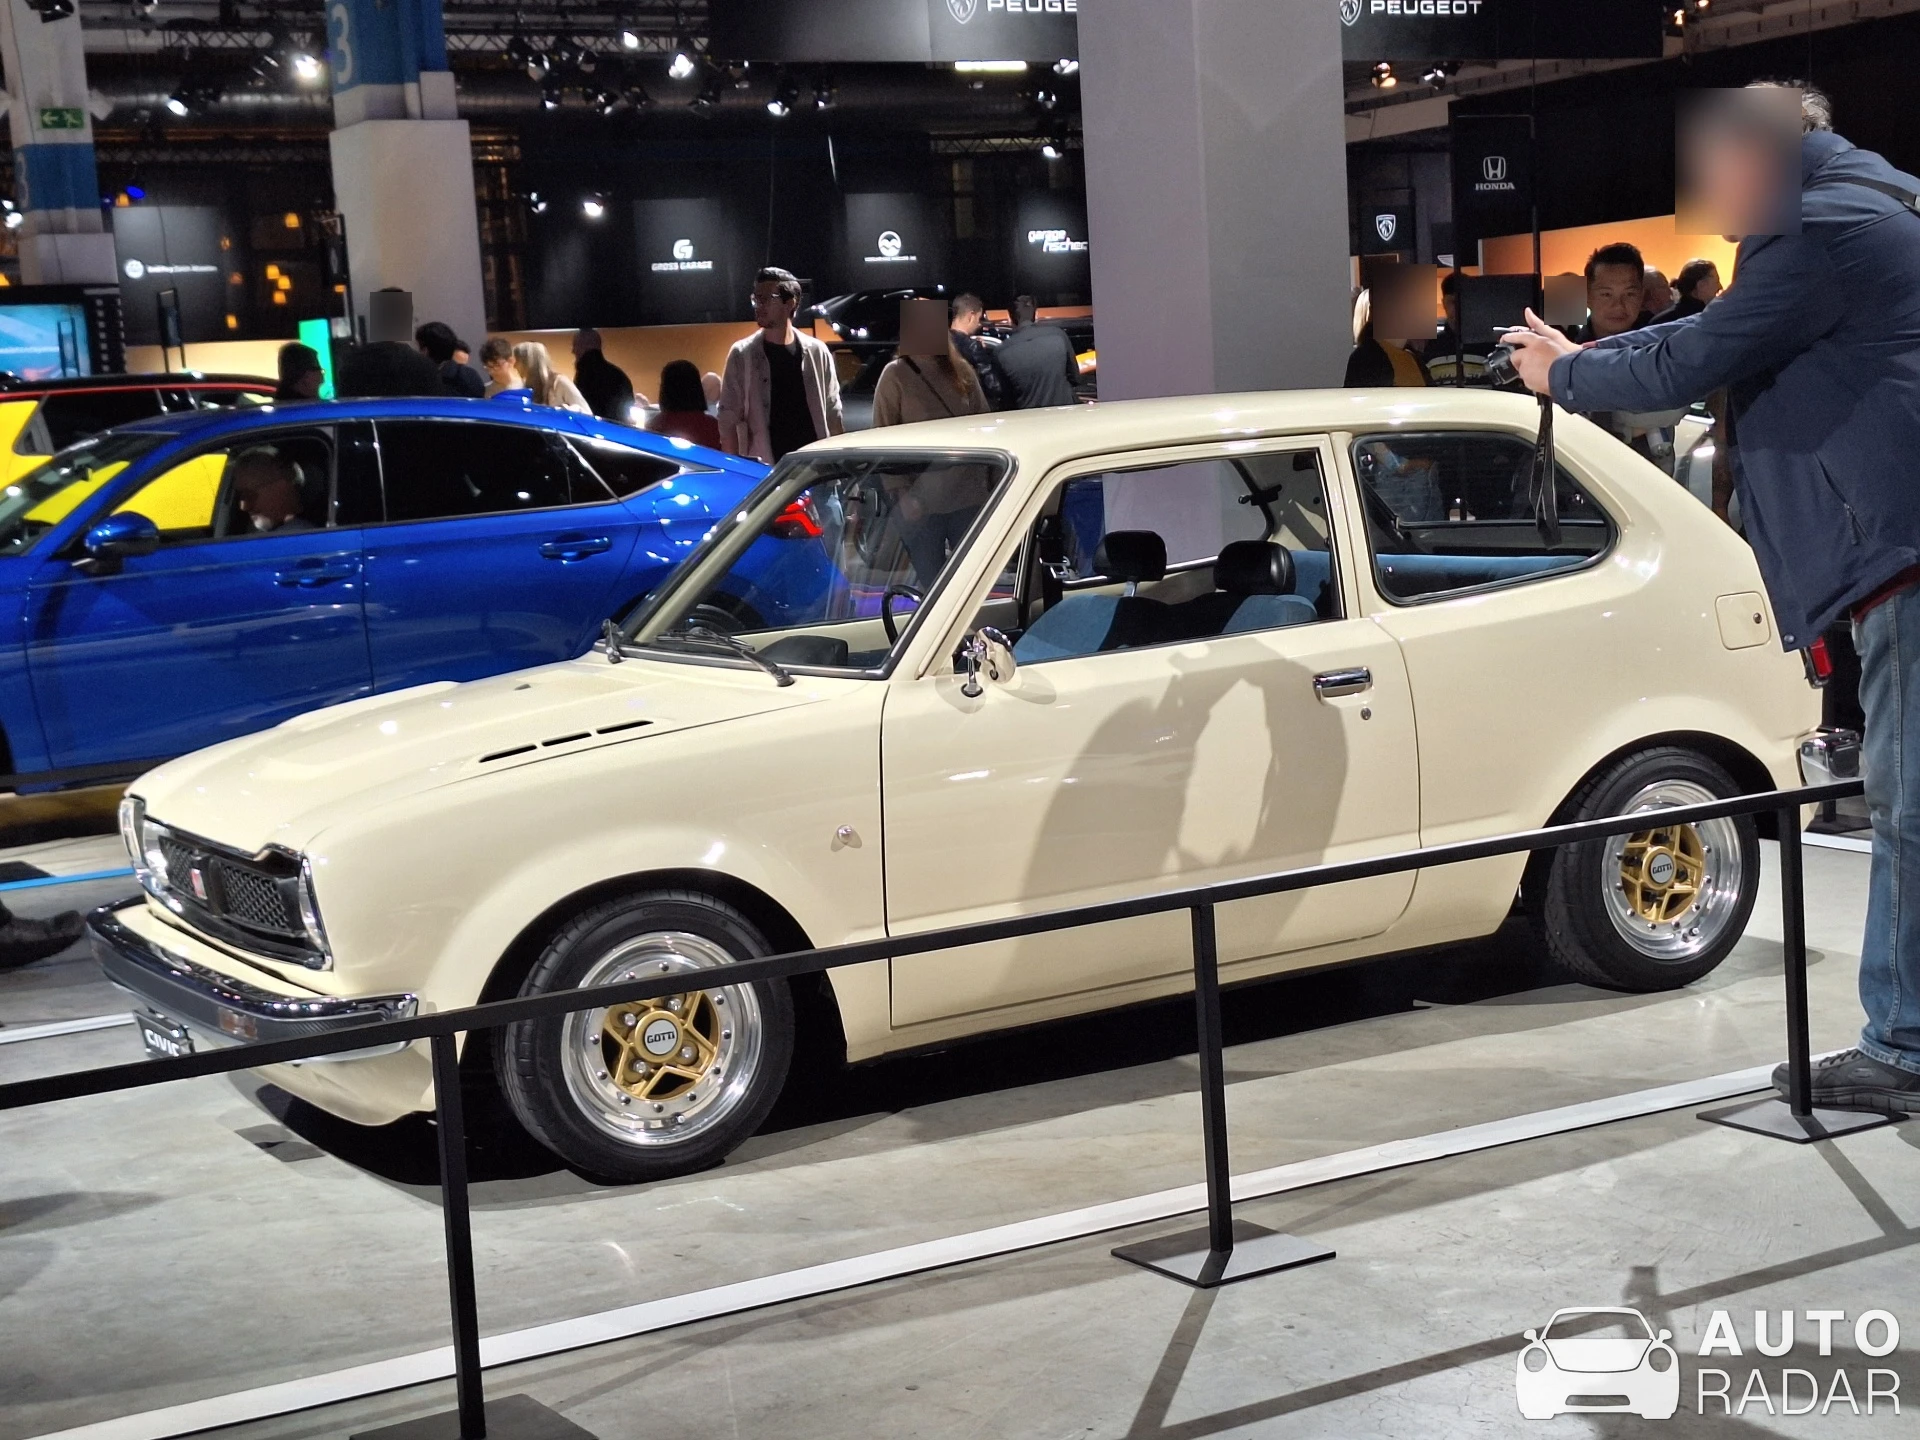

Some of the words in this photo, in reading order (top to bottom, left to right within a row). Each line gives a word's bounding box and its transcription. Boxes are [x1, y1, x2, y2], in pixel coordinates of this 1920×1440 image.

[1370, 0, 1482, 14] PEUGEOT
[331, 3, 352, 84] 3
[1475, 182, 1515, 191] HONDA
[1028, 230, 1066, 242] garage
[651, 263, 679, 271] GROSS
[680, 261, 713, 270] GARAGE
[145, 1029, 179, 1057] CIVIC
[647, 1031, 675, 1044] GOTTI
